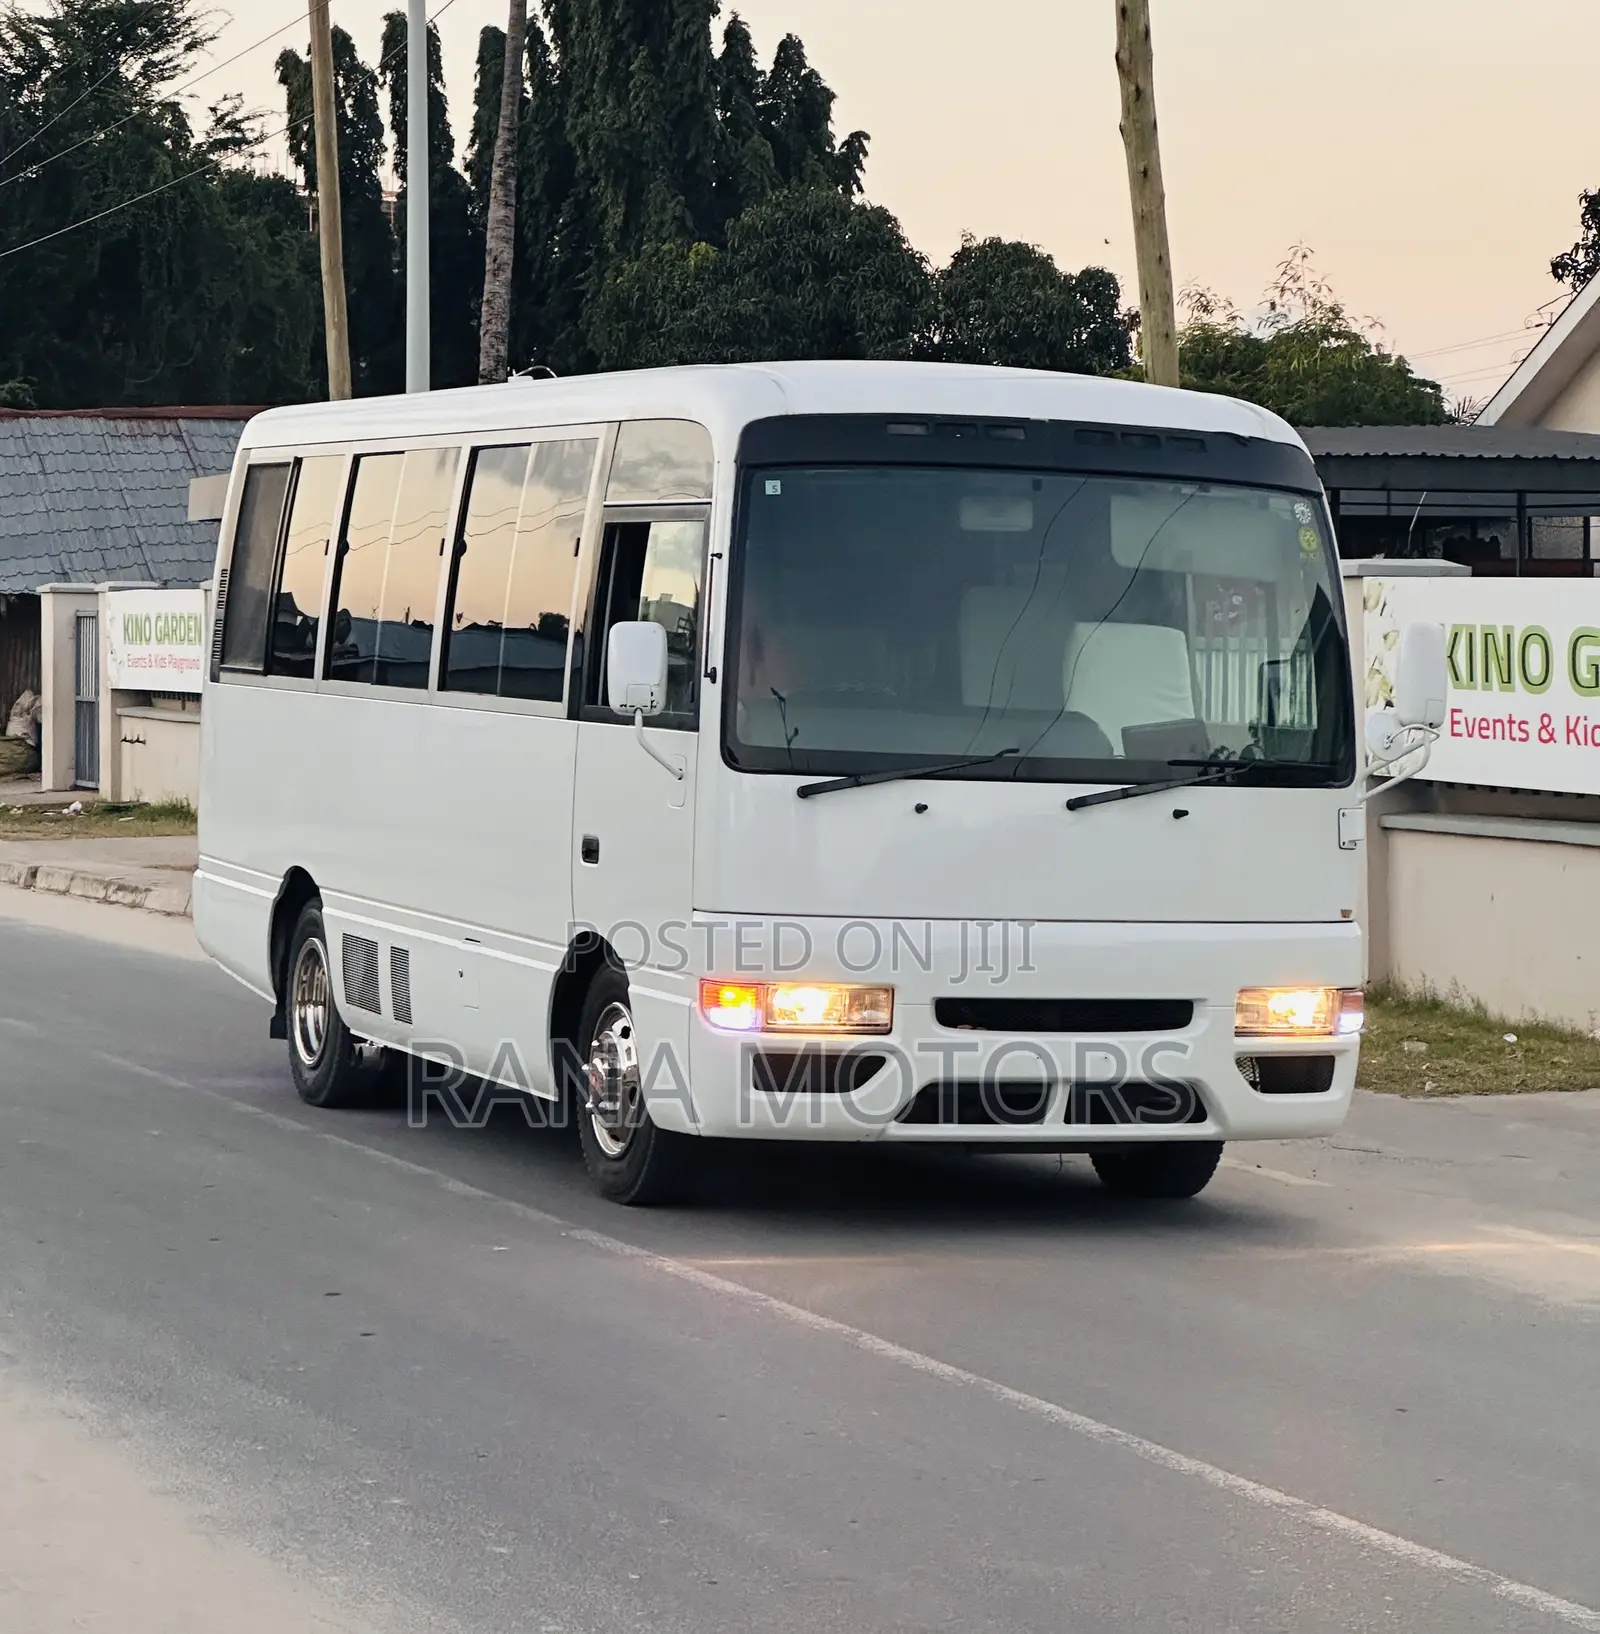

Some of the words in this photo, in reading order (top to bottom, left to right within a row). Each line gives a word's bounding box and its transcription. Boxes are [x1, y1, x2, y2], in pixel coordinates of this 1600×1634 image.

[123, 613, 152, 646] KINO
[155, 613, 202, 646] GARDEN
[127, 653, 147, 668] Events
[1450, 708, 1530, 742] Events
[1537, 713, 1557, 744] &
